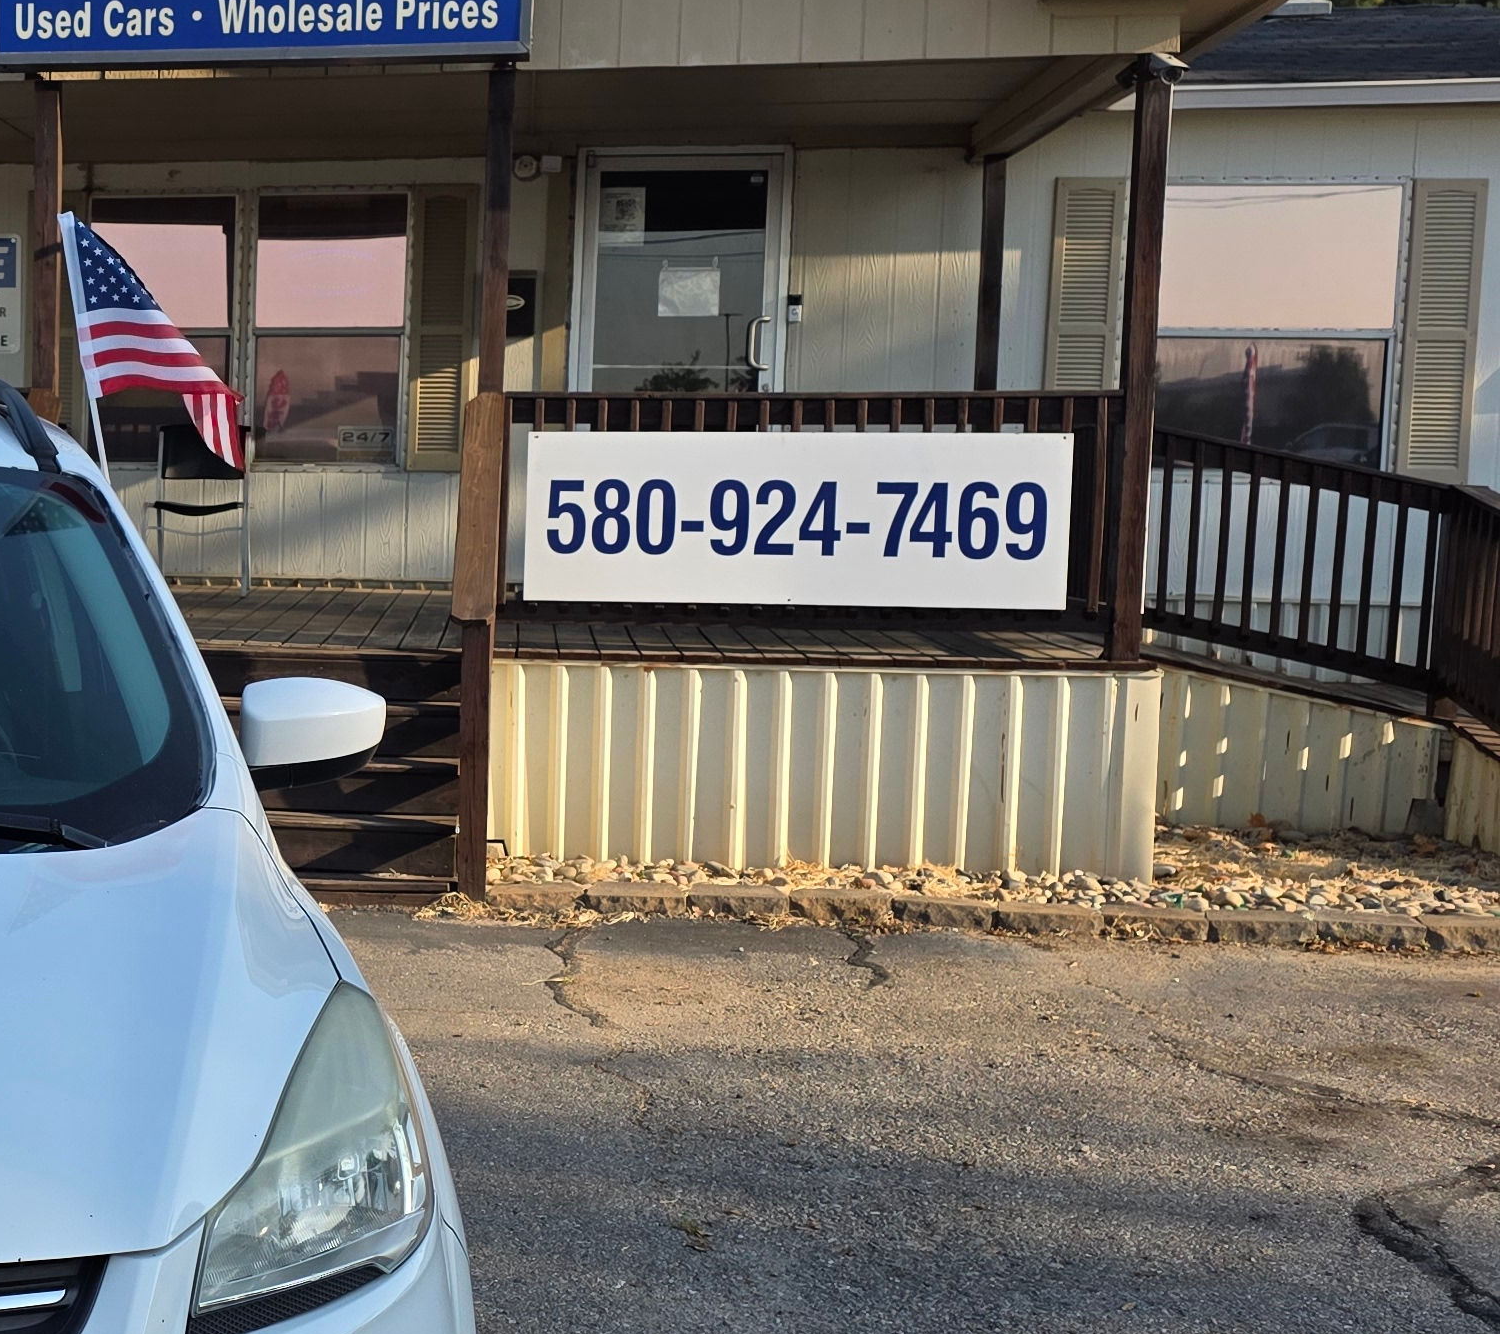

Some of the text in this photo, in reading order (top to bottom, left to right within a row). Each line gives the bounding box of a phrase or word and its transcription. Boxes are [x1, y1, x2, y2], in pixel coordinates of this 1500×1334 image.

[15, 1, 92, 40] Used
[103, 0, 175, 37] Cars
[341, 431, 391, 443] 24/7
[545, 478, 1049, 561] 580-924-7469
